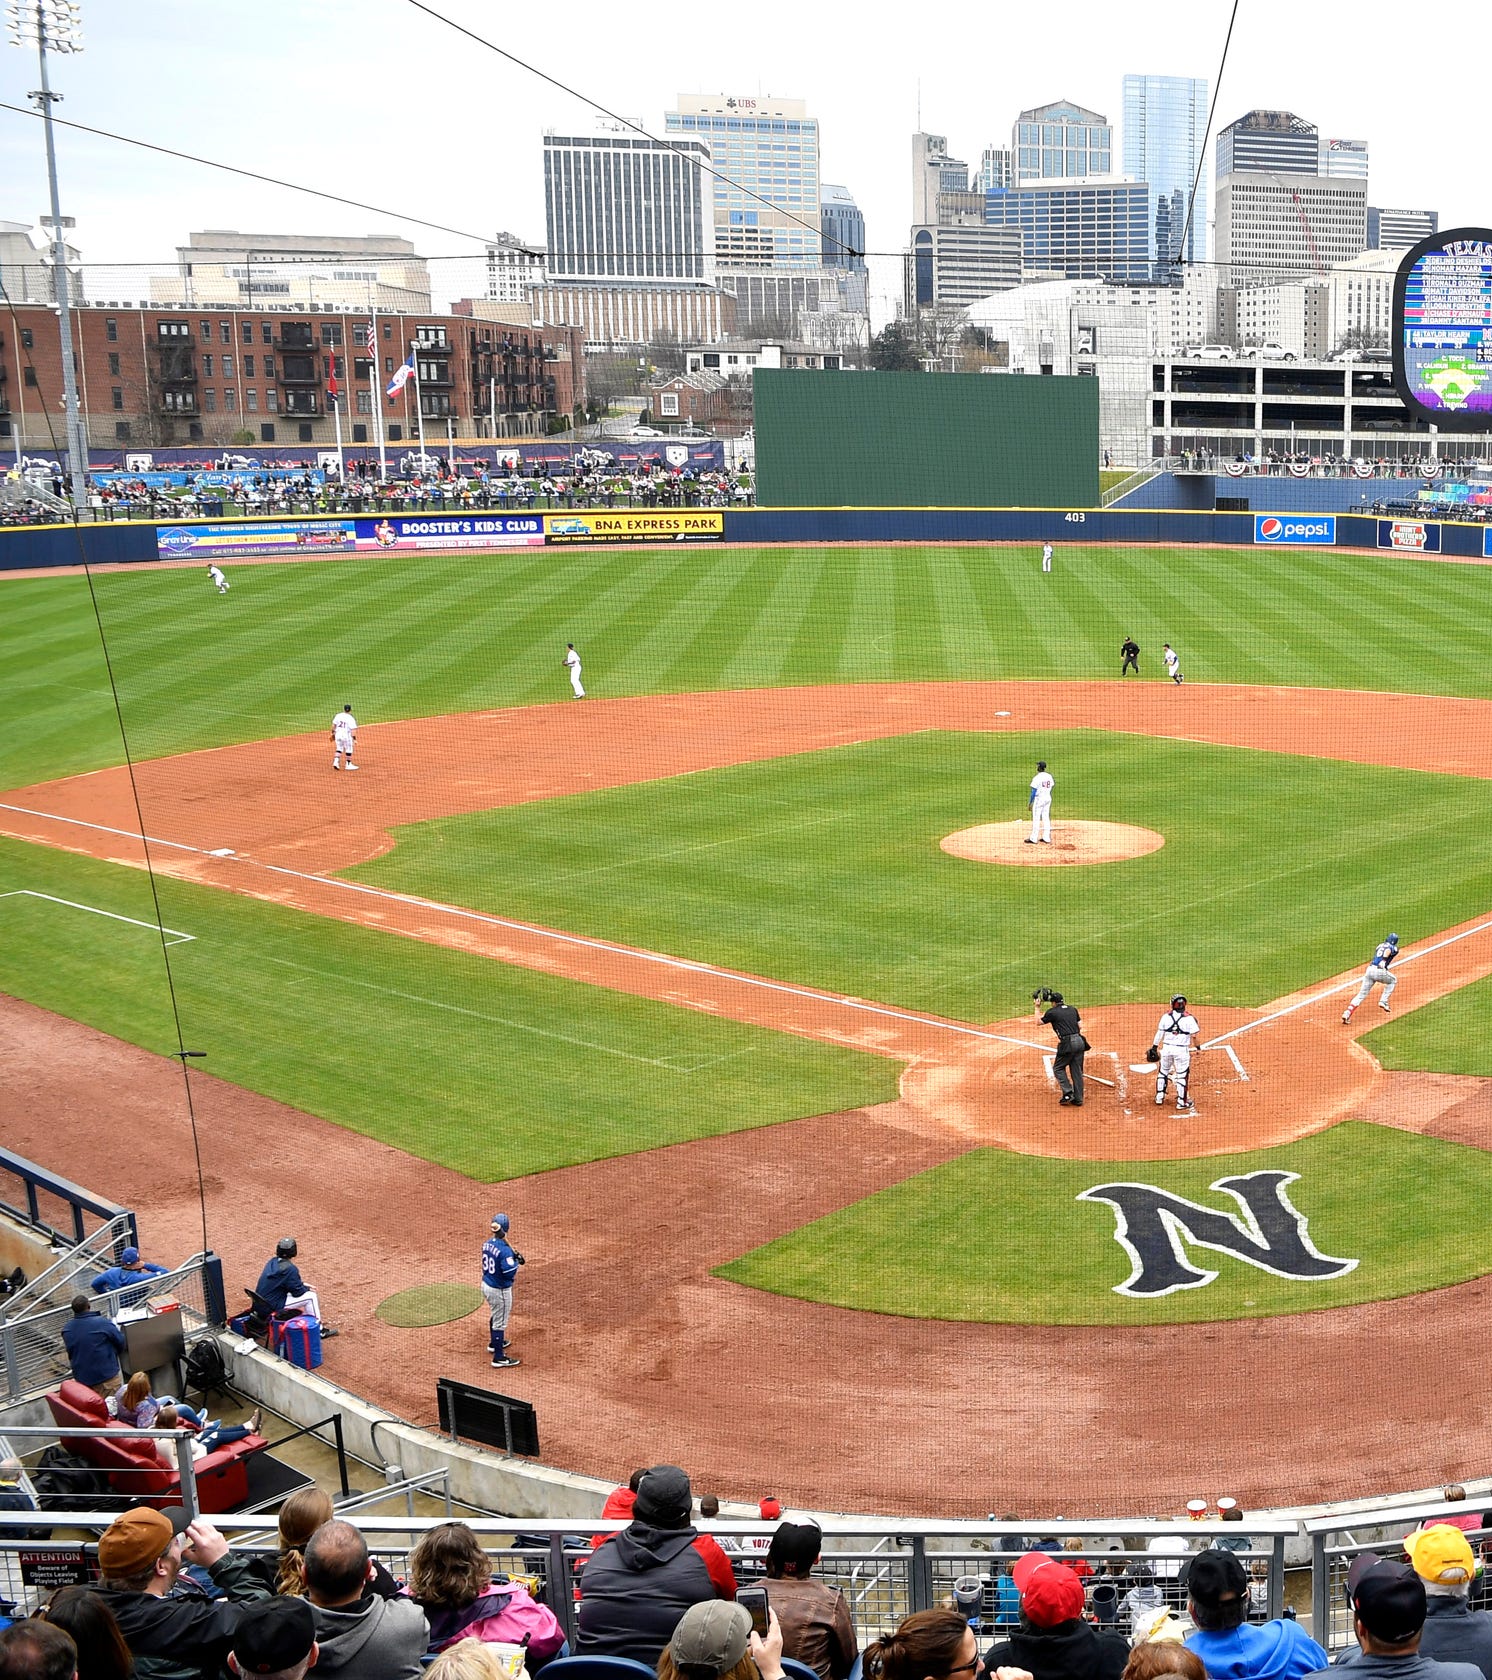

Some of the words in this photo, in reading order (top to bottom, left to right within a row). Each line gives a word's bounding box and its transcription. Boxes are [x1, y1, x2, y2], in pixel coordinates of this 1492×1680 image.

[738, 99, 757, 108] UBS
[1064, 513, 1086, 523] 403
[402, 521, 471, 534] BOOSTER'S
[475, 521, 503, 533] KIDS
[506, 520, 538, 532] CLUB
[595, 520, 623, 530] BNA
[627, 520, 680, 529] EXPRESS
[684, 519, 717, 528] PARK
[1399, 525, 1417, 533] HUNT
[1284, 522, 1329, 538] pepsi
[1398, 538, 1417, 546] PIZZA
[1075, 1169, 1360, 1298] N
[482, 1253, 496, 1274] 38
[752, 1538, 771, 1549] VOTT
[22, 1552, 80, 1562] ATTENTION
[30, 1571, 53, 1579] Objects
[53, 1571, 78, 1579] Leaving
